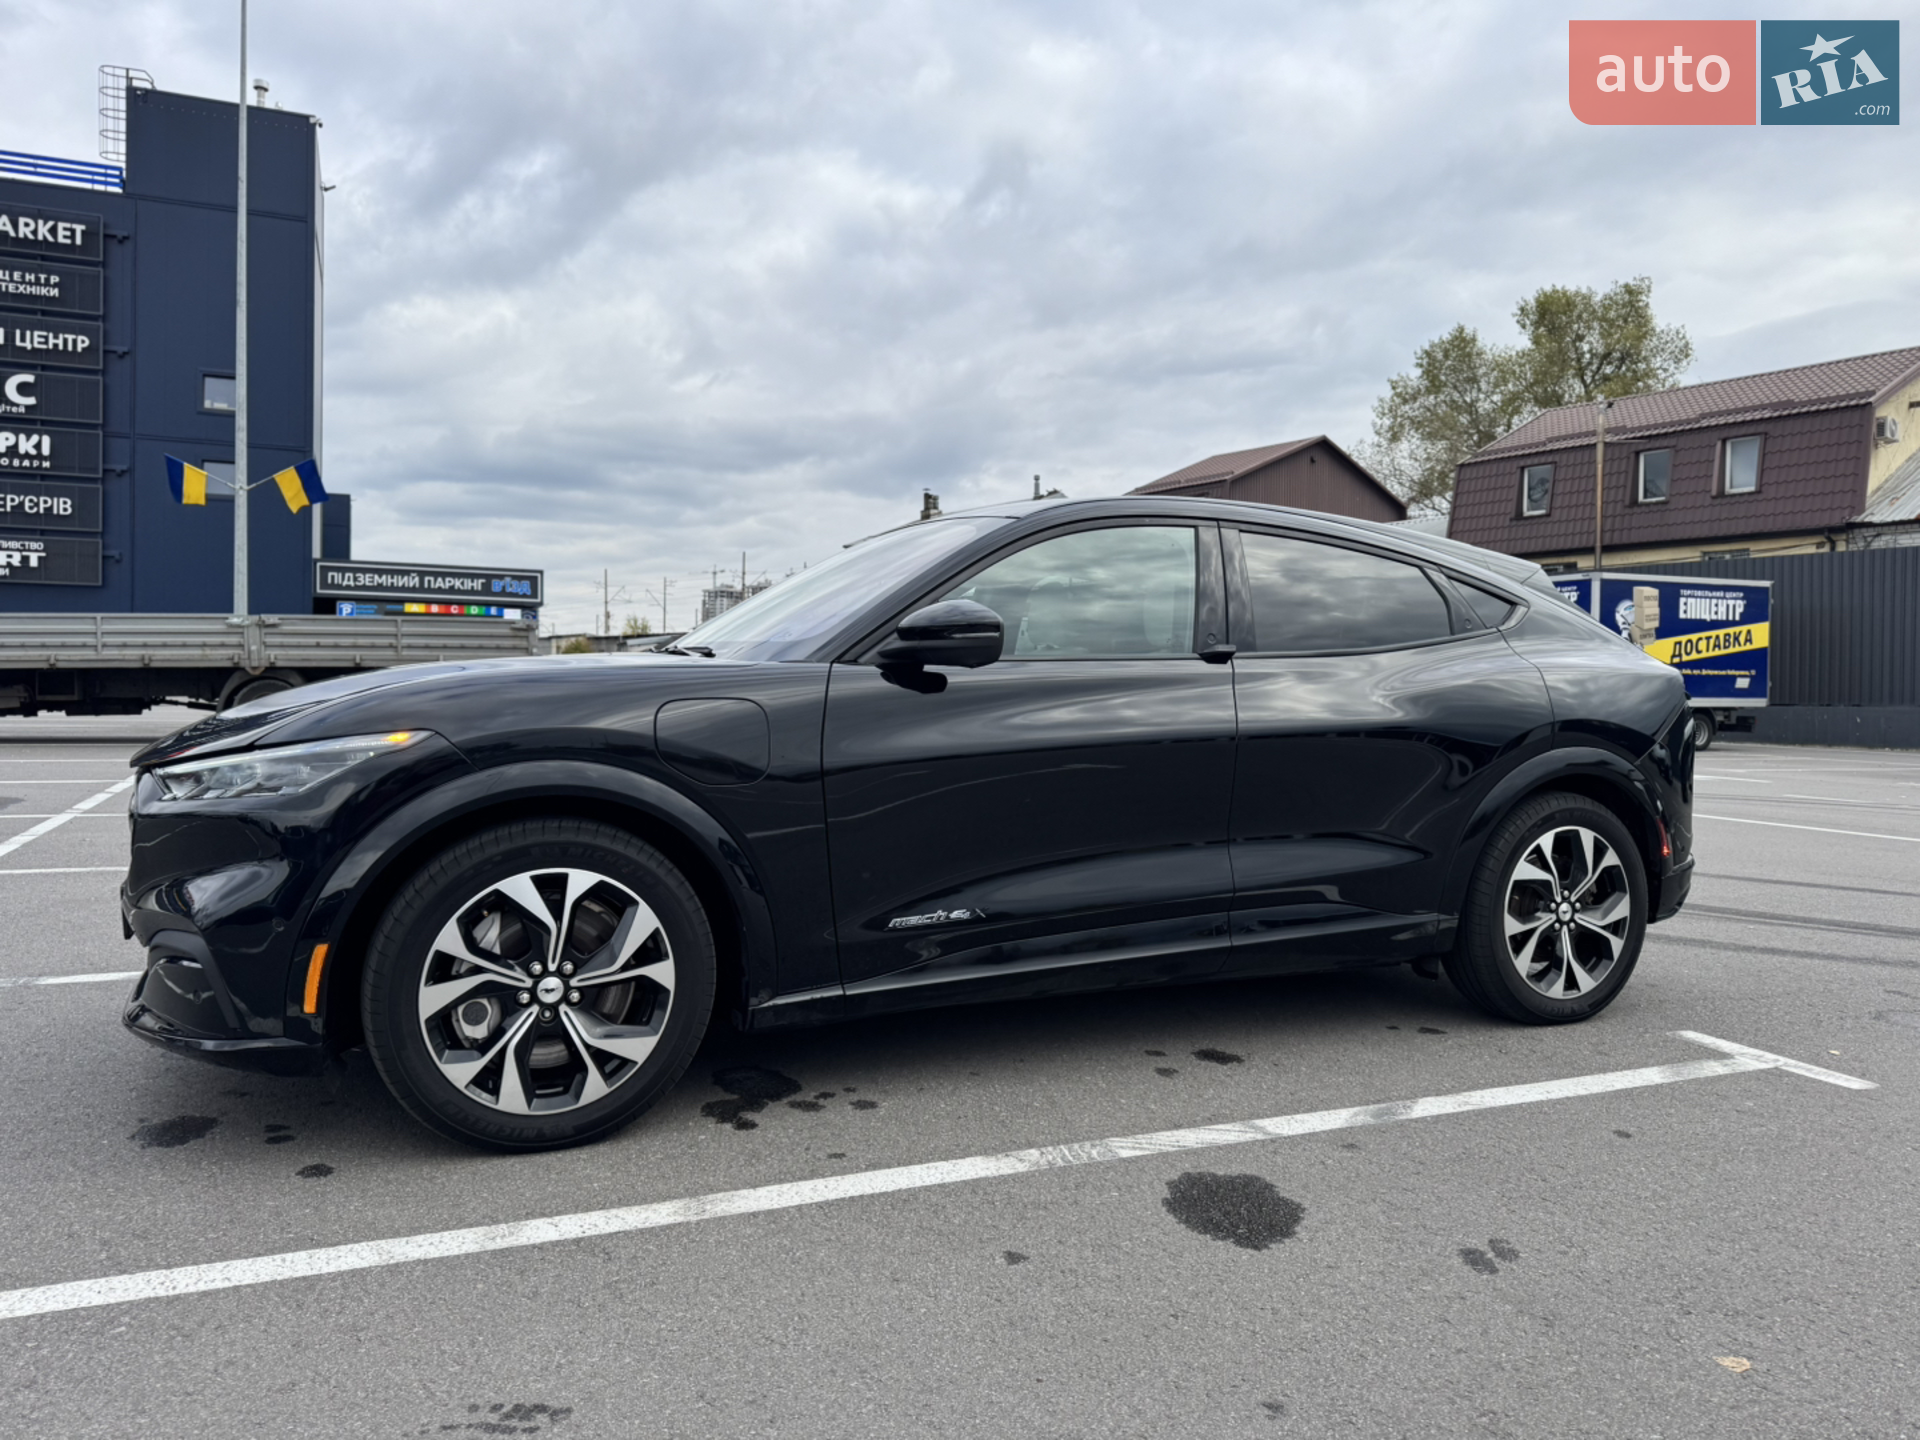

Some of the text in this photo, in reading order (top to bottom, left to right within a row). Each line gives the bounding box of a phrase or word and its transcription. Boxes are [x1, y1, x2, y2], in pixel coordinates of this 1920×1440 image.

[15, 328, 90, 353] ЦЕНТР
[327, 571, 419, 588] ПІДЗЕМНИЙ
[424, 576, 486, 591] ПАРКІНГ
[1670, 629, 1753, 664] ДОСТАВКА
